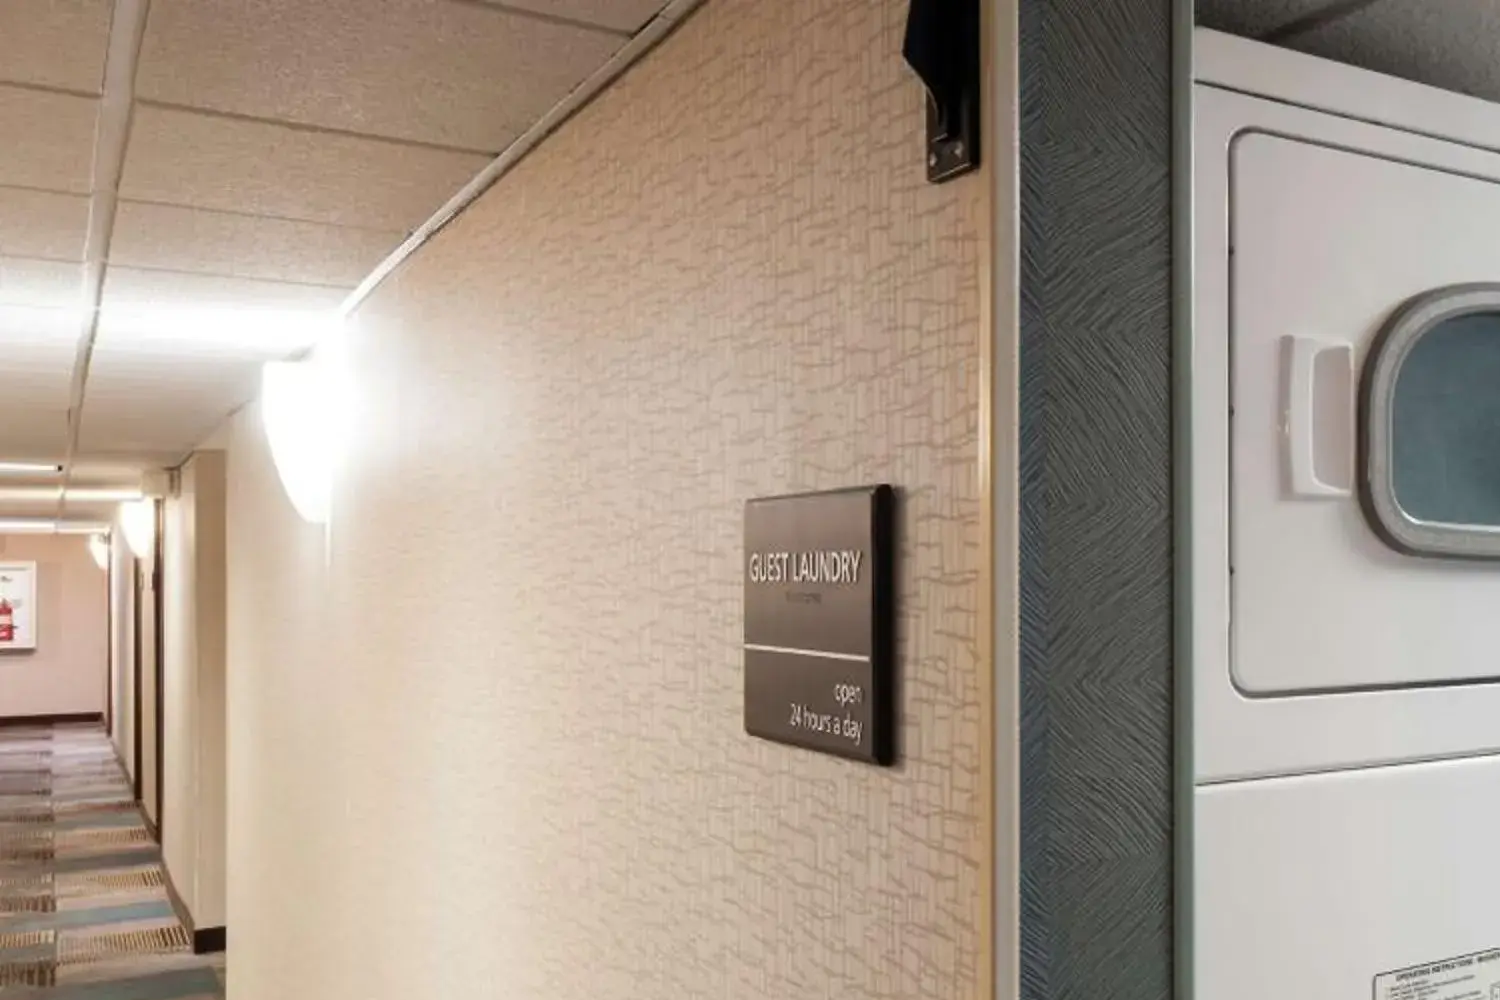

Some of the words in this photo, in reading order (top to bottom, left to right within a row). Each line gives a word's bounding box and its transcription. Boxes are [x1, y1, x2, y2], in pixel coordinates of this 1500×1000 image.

[750, 552, 788, 583] GUEST
[793, 550, 861, 583] LAUNDRY
[833, 684, 862, 708] open
[790, 703, 801, 726] 24
[802, 704, 831, 733] hours
[833, 716, 840, 735] a
[842, 711, 863, 746] day
